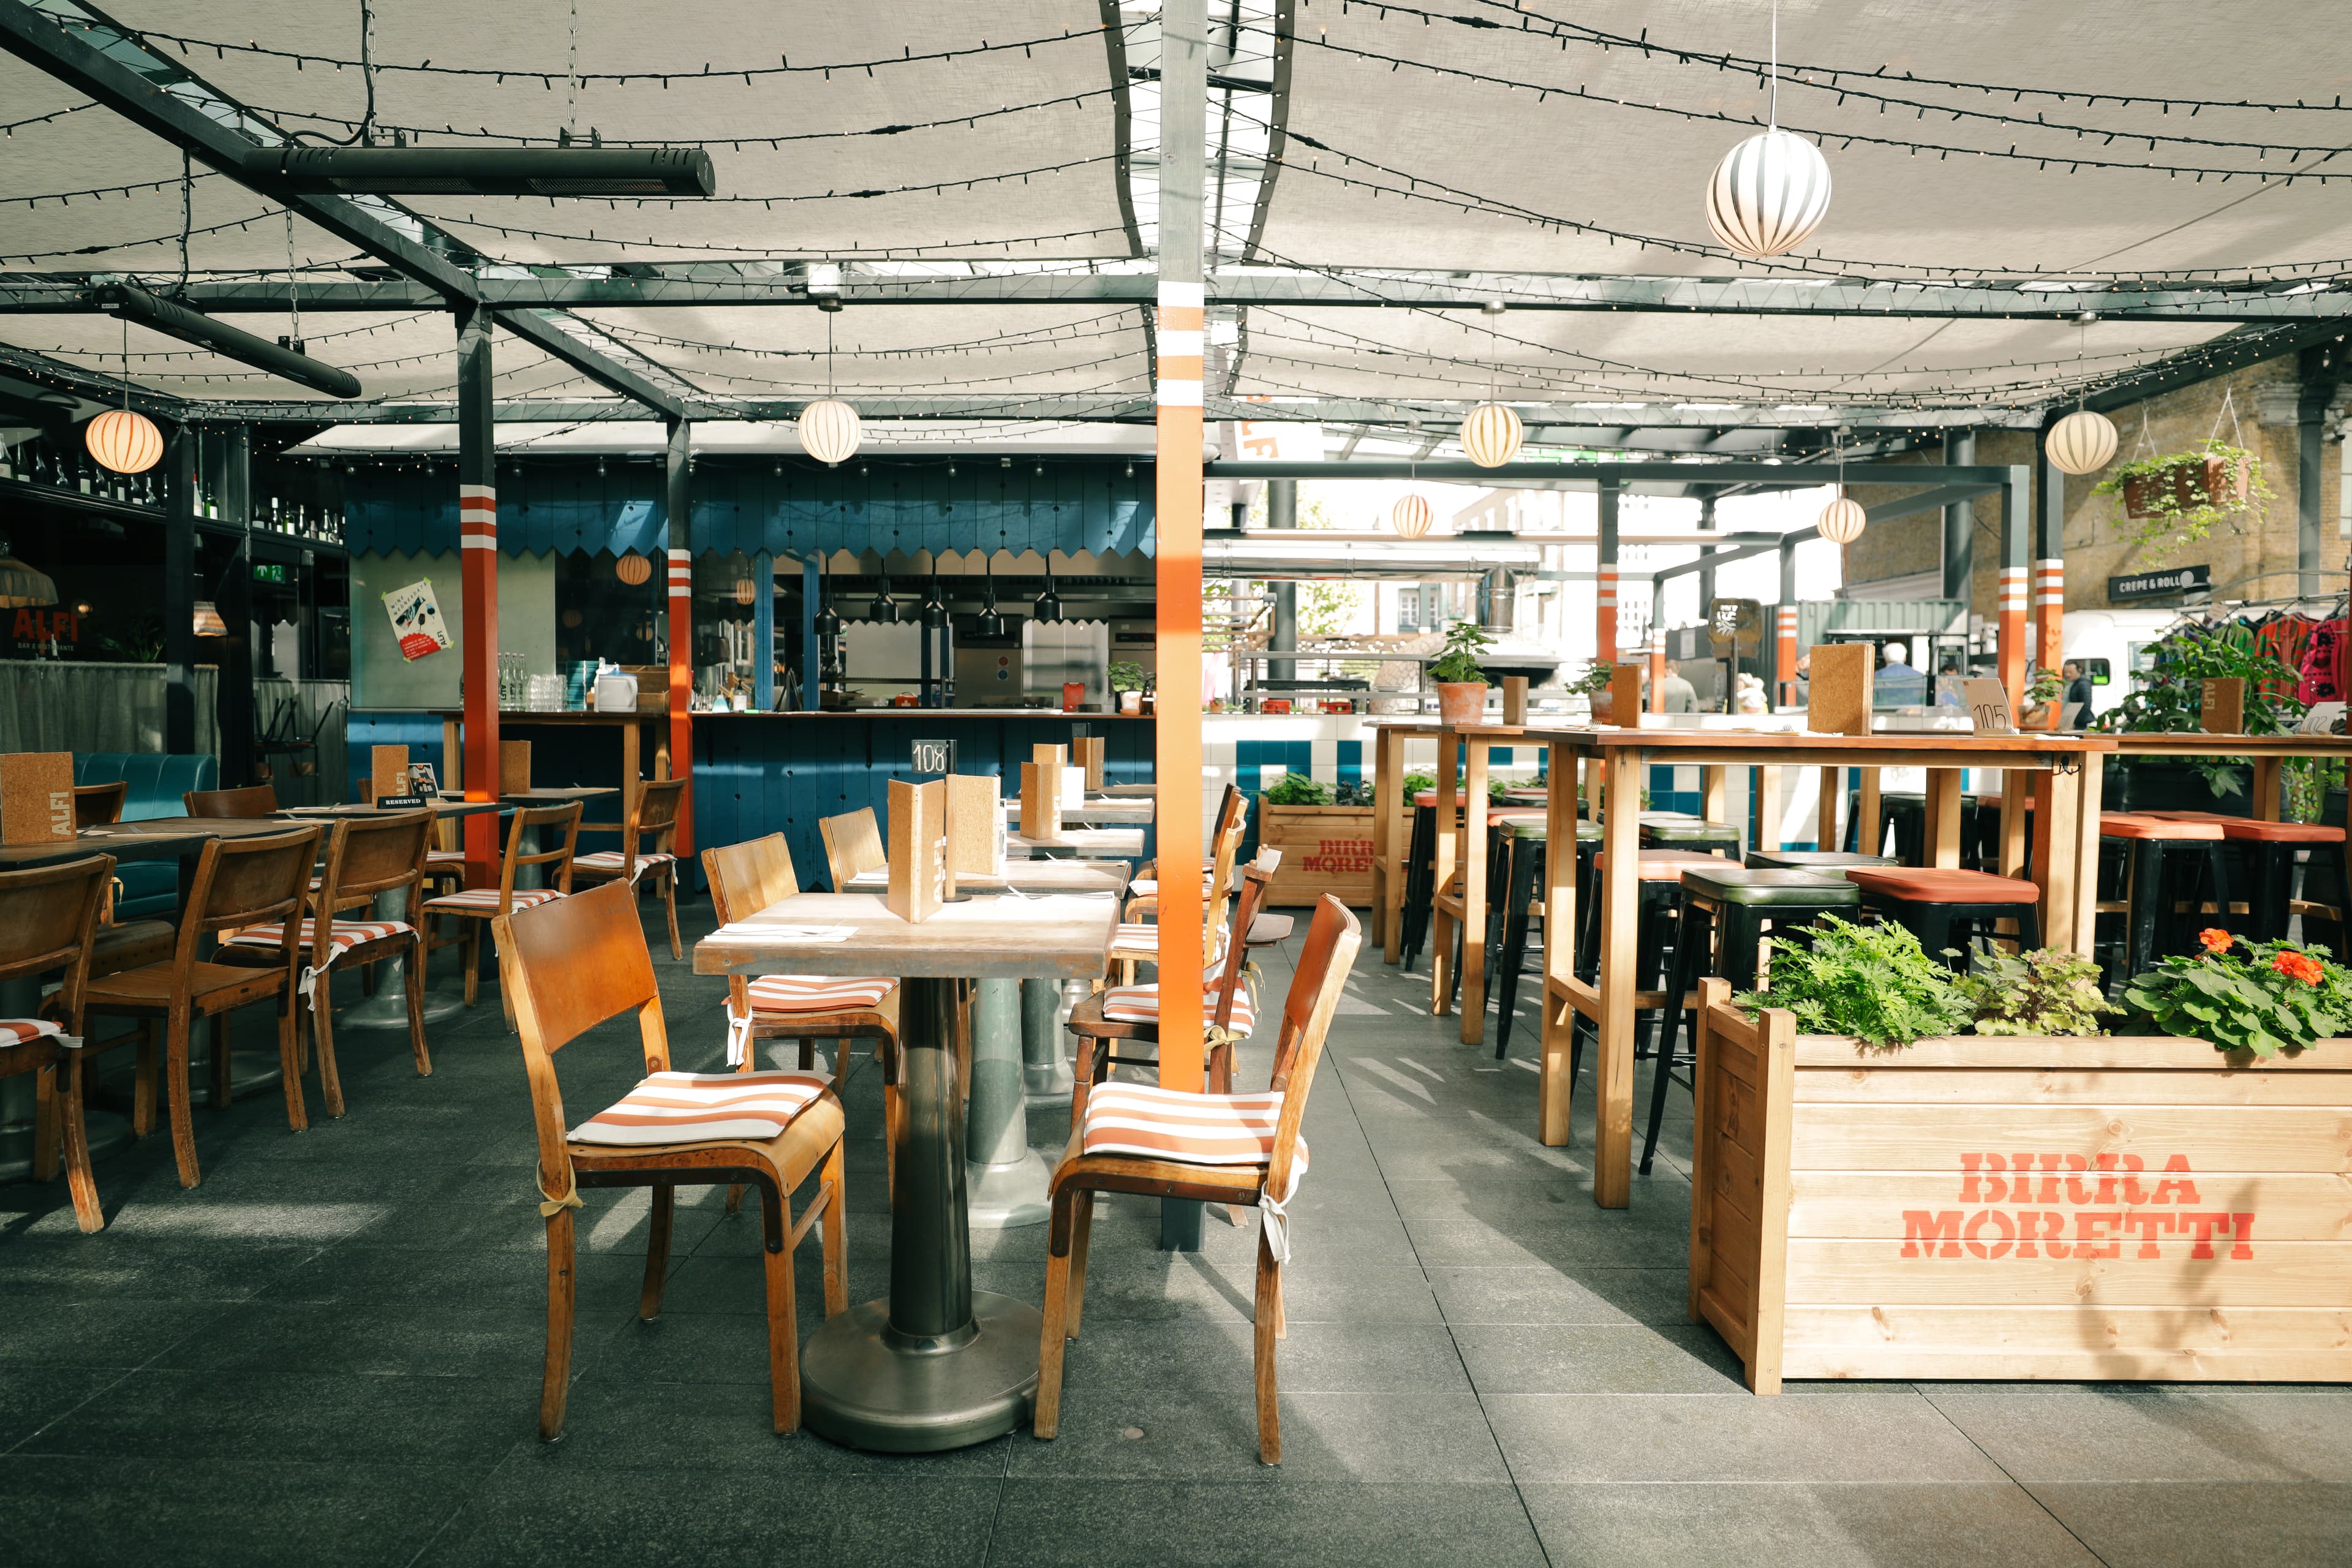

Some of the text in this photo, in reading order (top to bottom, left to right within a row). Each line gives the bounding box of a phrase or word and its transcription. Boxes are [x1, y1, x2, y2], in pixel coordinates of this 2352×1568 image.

[2119, 576, 2180, 592] CREPE & ROLL
[391, 595, 403, 609] WINE
[13, 609, 78, 642] ALFI
[437, 631, 447, 645] ALFI
[2204, 681, 2215, 710] ALFI
[1973, 704, 2007, 729] 105
[913, 744, 944, 772] 108
[50, 791, 72, 836] ALFI
[1319, 840, 1374, 856] BIRR
[1302, 856, 1374, 872] MORE
[1958, 1153, 2201, 1204] BIRRA
[1900, 1210, 2255, 1260] MORETTI
